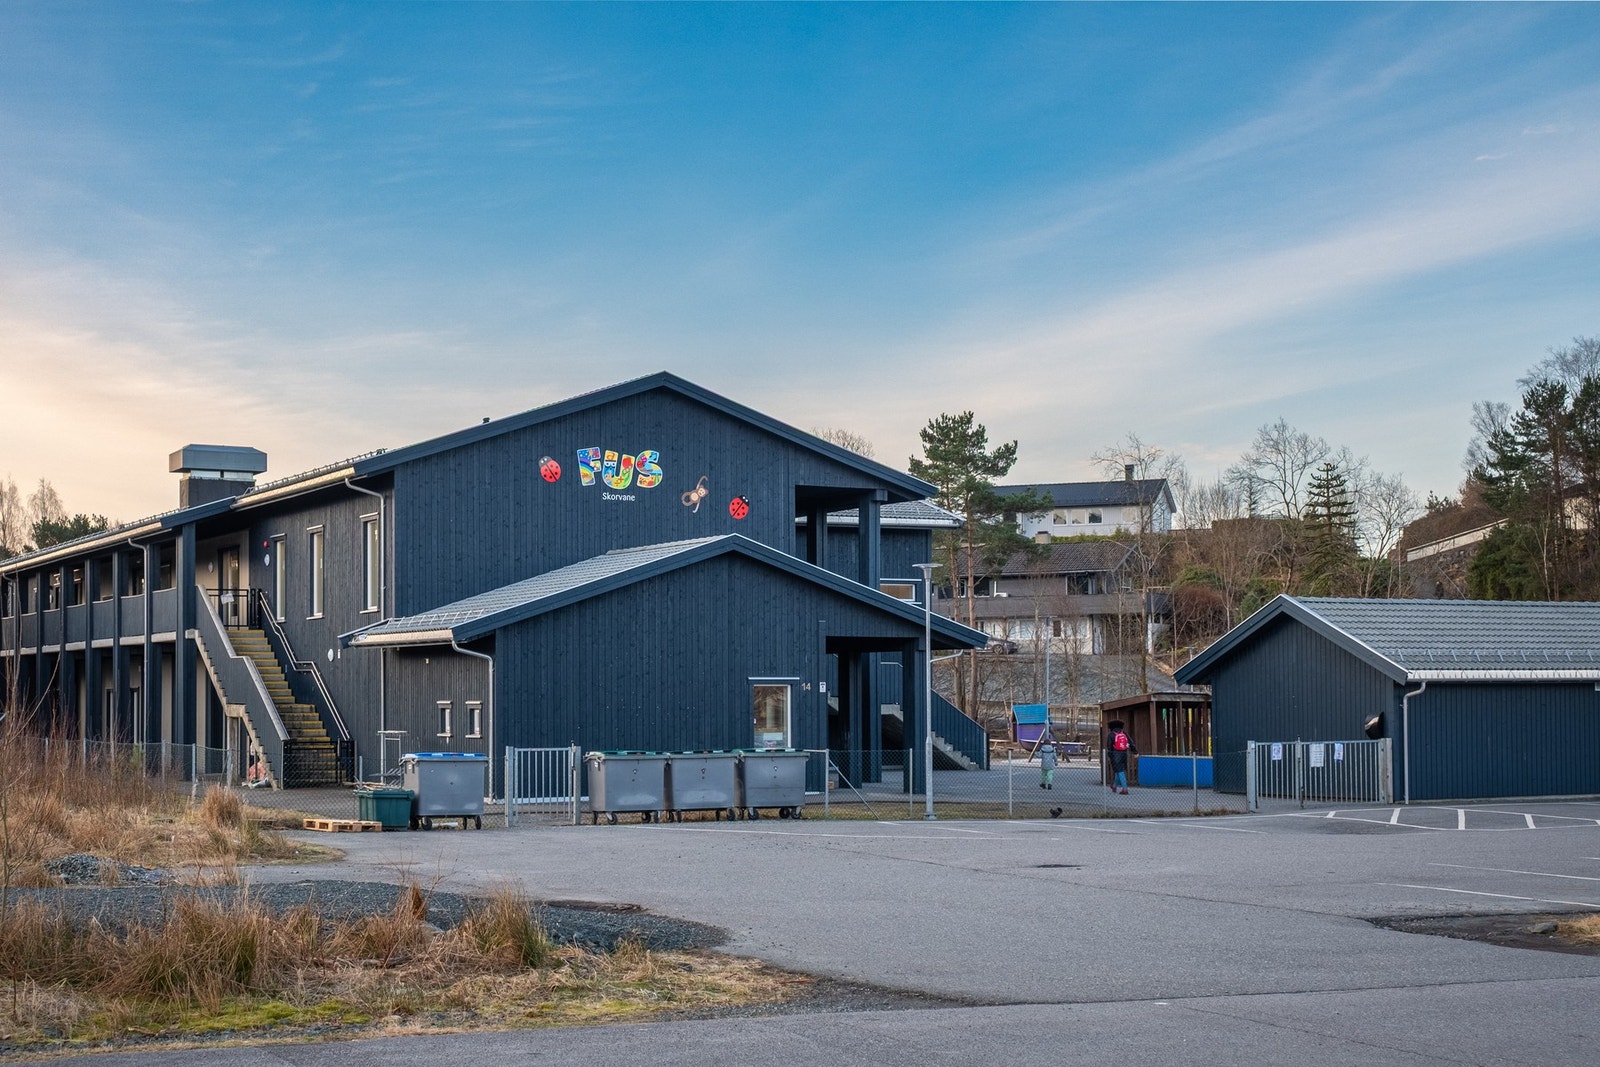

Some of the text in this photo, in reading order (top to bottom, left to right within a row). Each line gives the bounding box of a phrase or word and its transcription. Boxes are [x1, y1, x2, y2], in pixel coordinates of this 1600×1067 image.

[577, 447, 663, 490] FUS
[602, 492, 636, 502] Skorvane
[801, 682, 811, 691] 14
